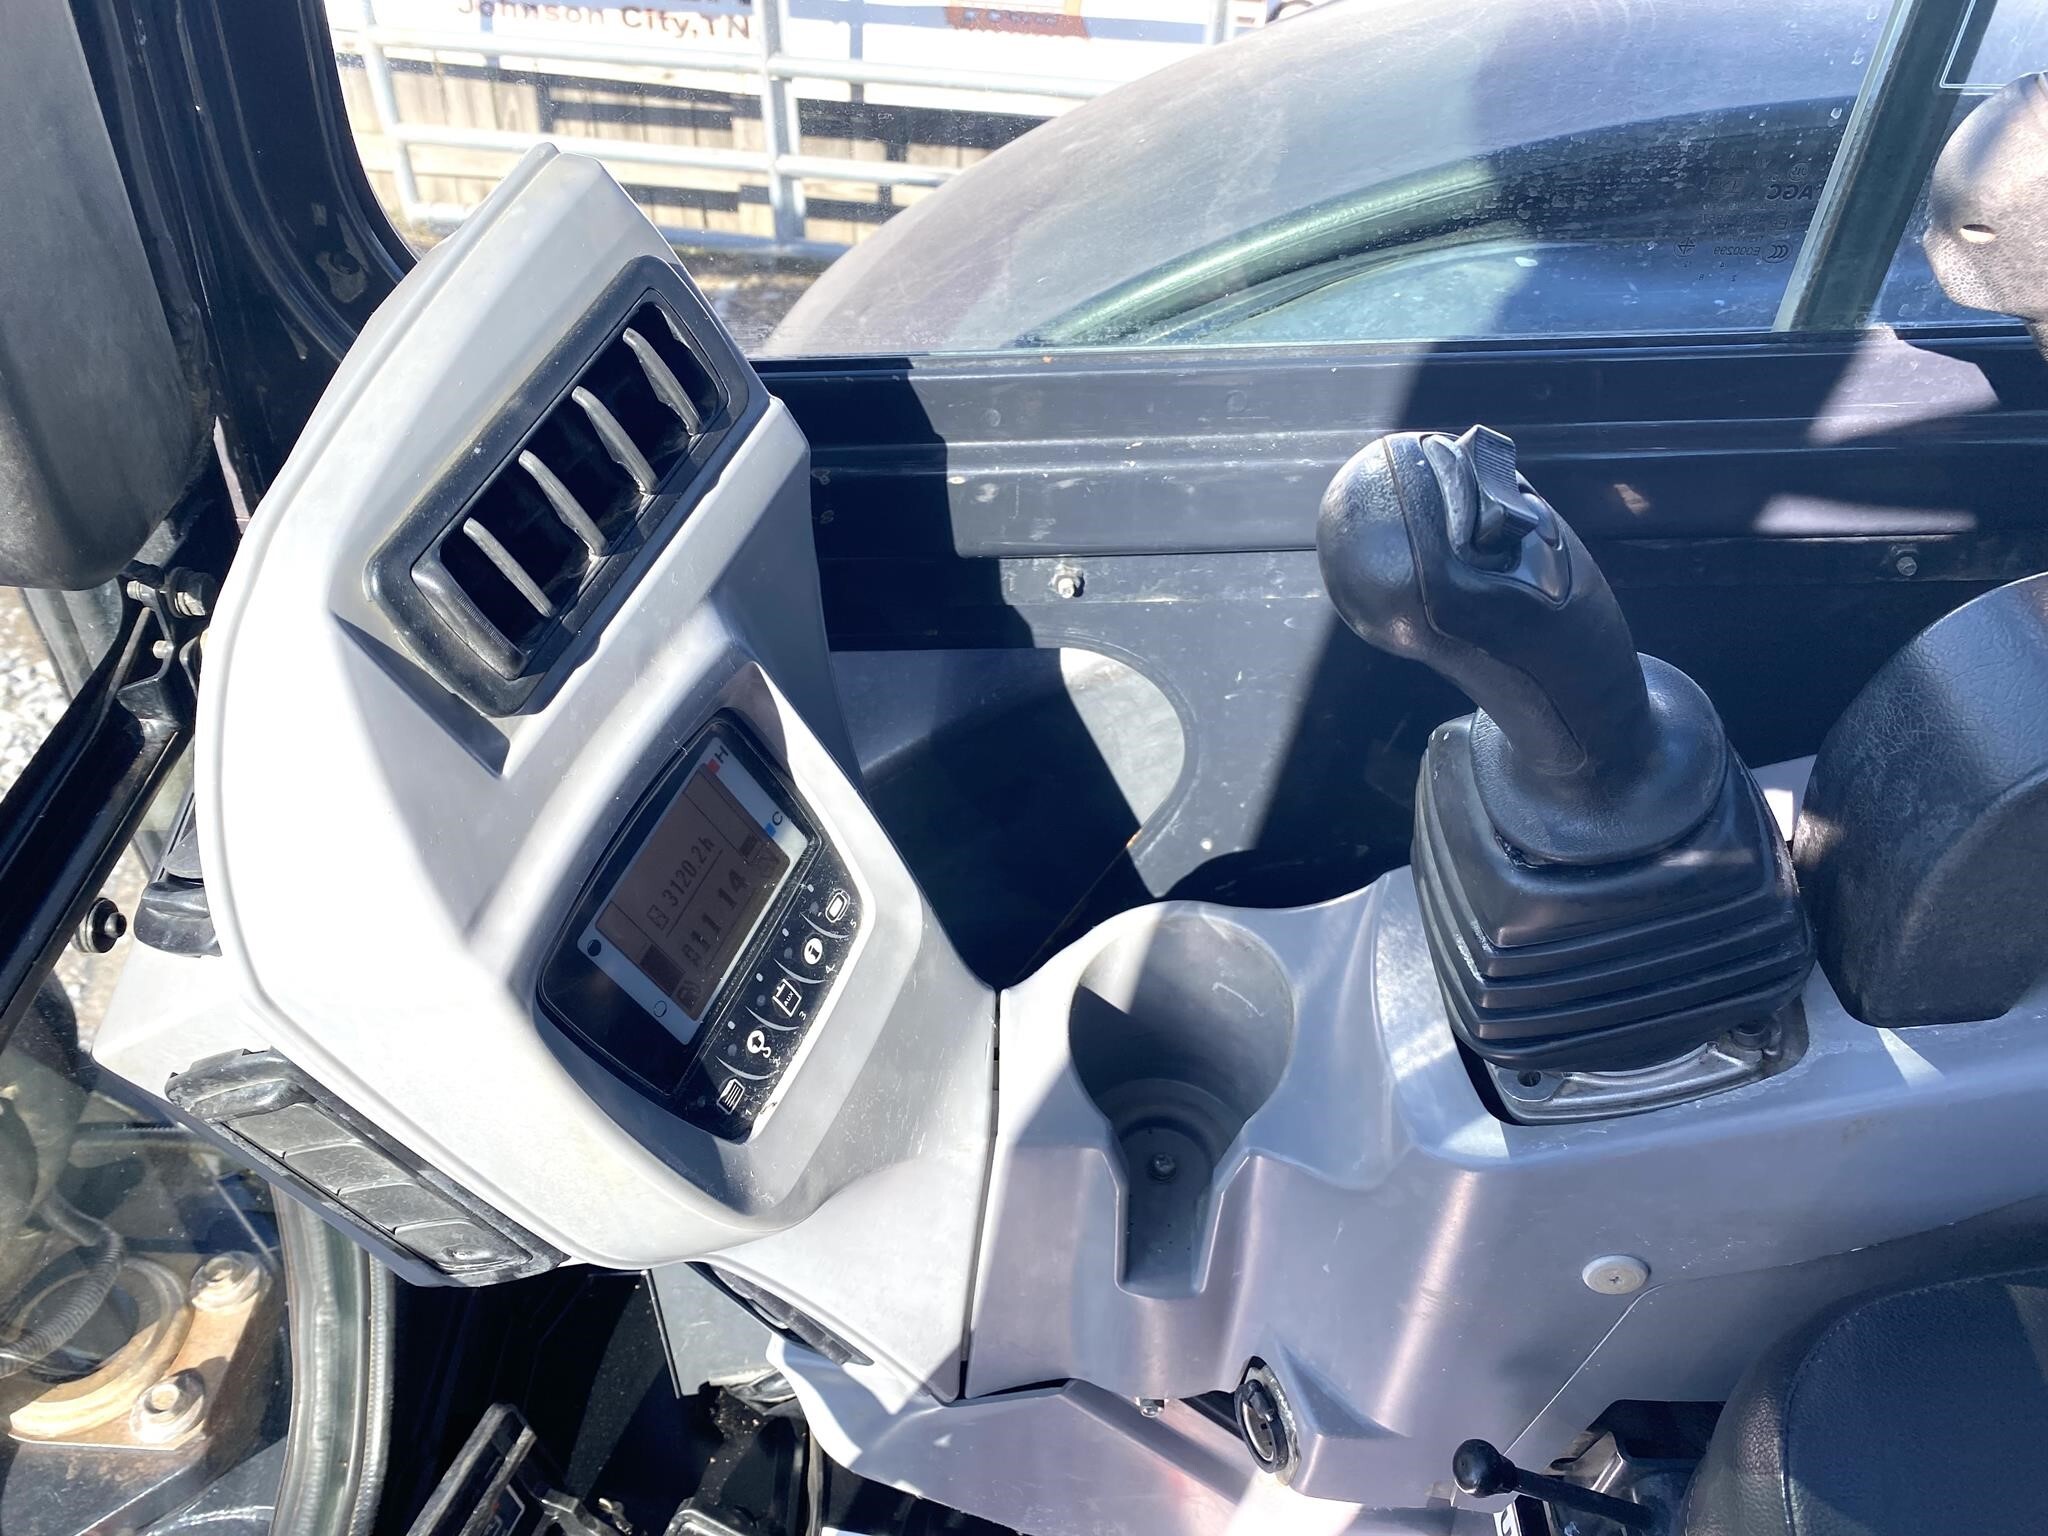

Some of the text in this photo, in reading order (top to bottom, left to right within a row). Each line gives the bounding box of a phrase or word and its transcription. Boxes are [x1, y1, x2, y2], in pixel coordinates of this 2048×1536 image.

[714, 746, 729, 764] H
[772, 811, 783, 826] C
[783, 991, 794, 1007] AUX
[799, 1011, 807, 1020] 3
